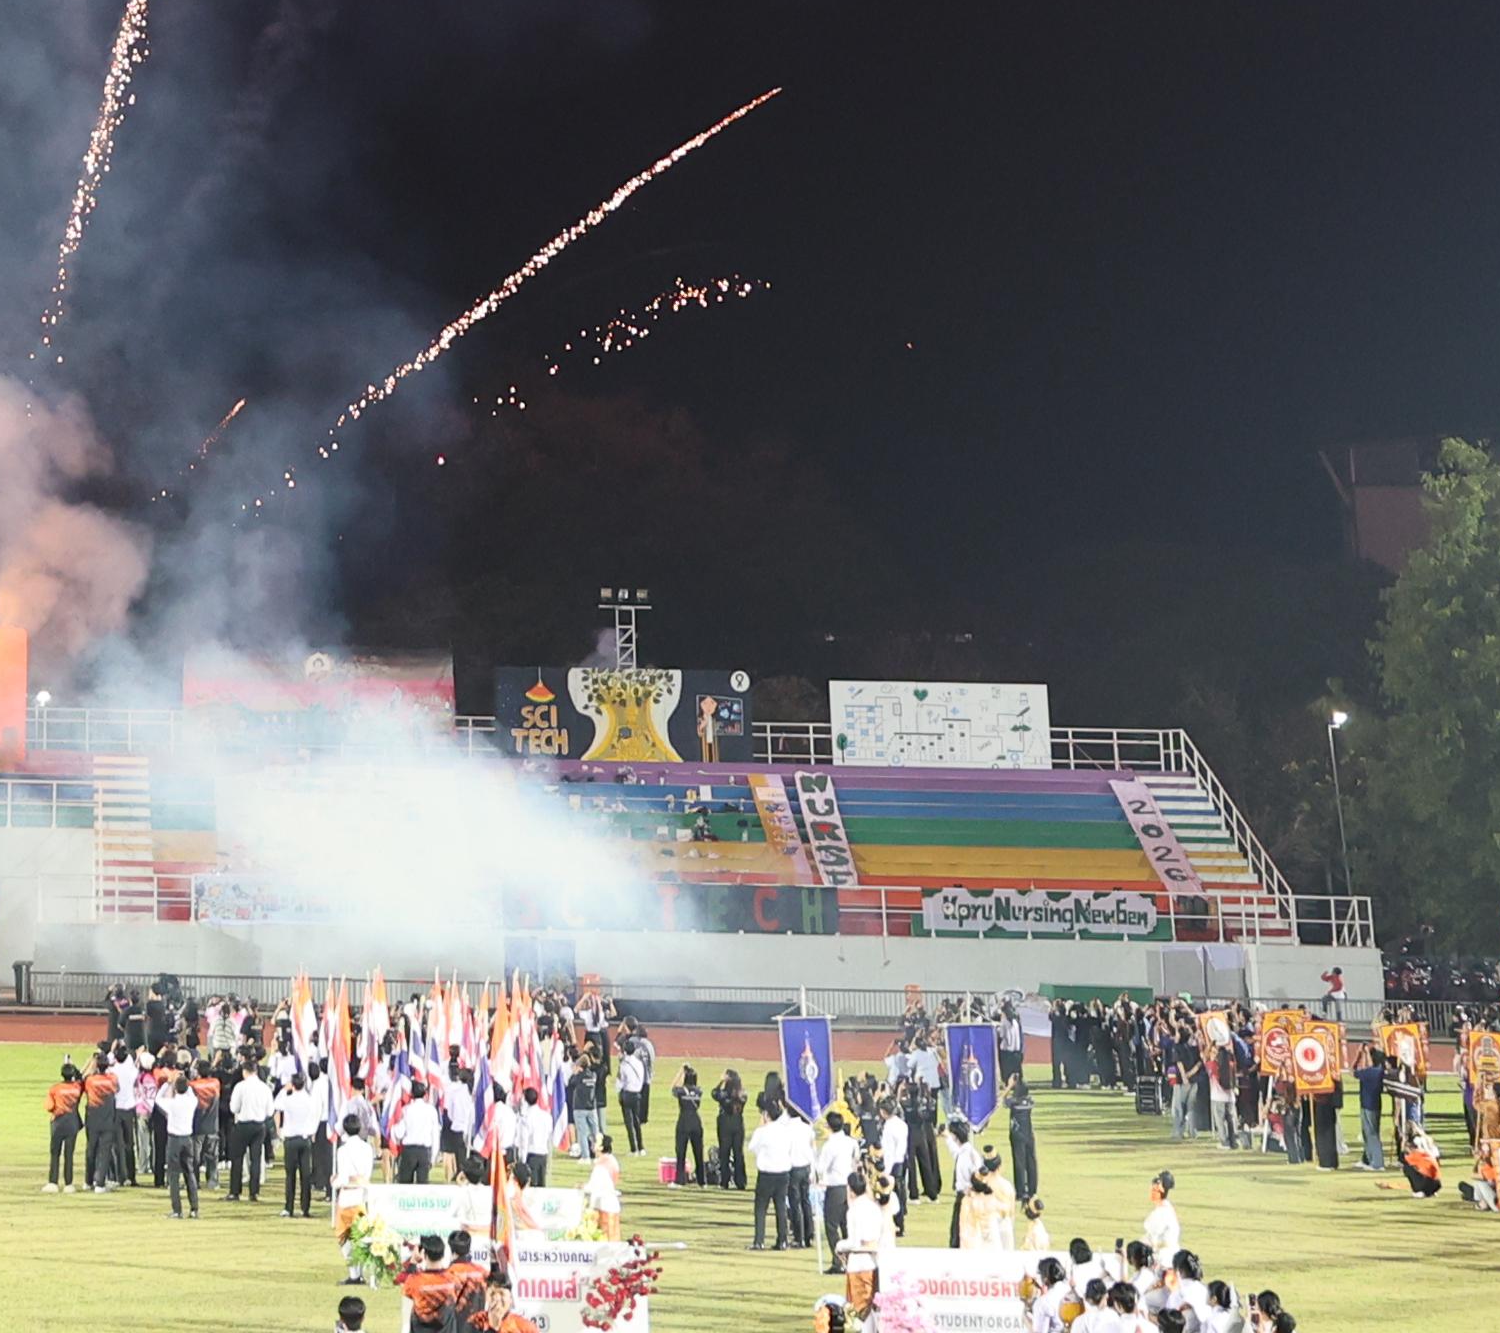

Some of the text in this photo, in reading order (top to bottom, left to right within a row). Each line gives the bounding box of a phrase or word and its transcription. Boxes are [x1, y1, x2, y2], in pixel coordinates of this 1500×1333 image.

[521, 704, 558, 729] SCI
[511, 727, 569, 756] TECH
[1127, 799, 1188, 883] 2026
[934, 1314, 984, 1328] STUDENT
